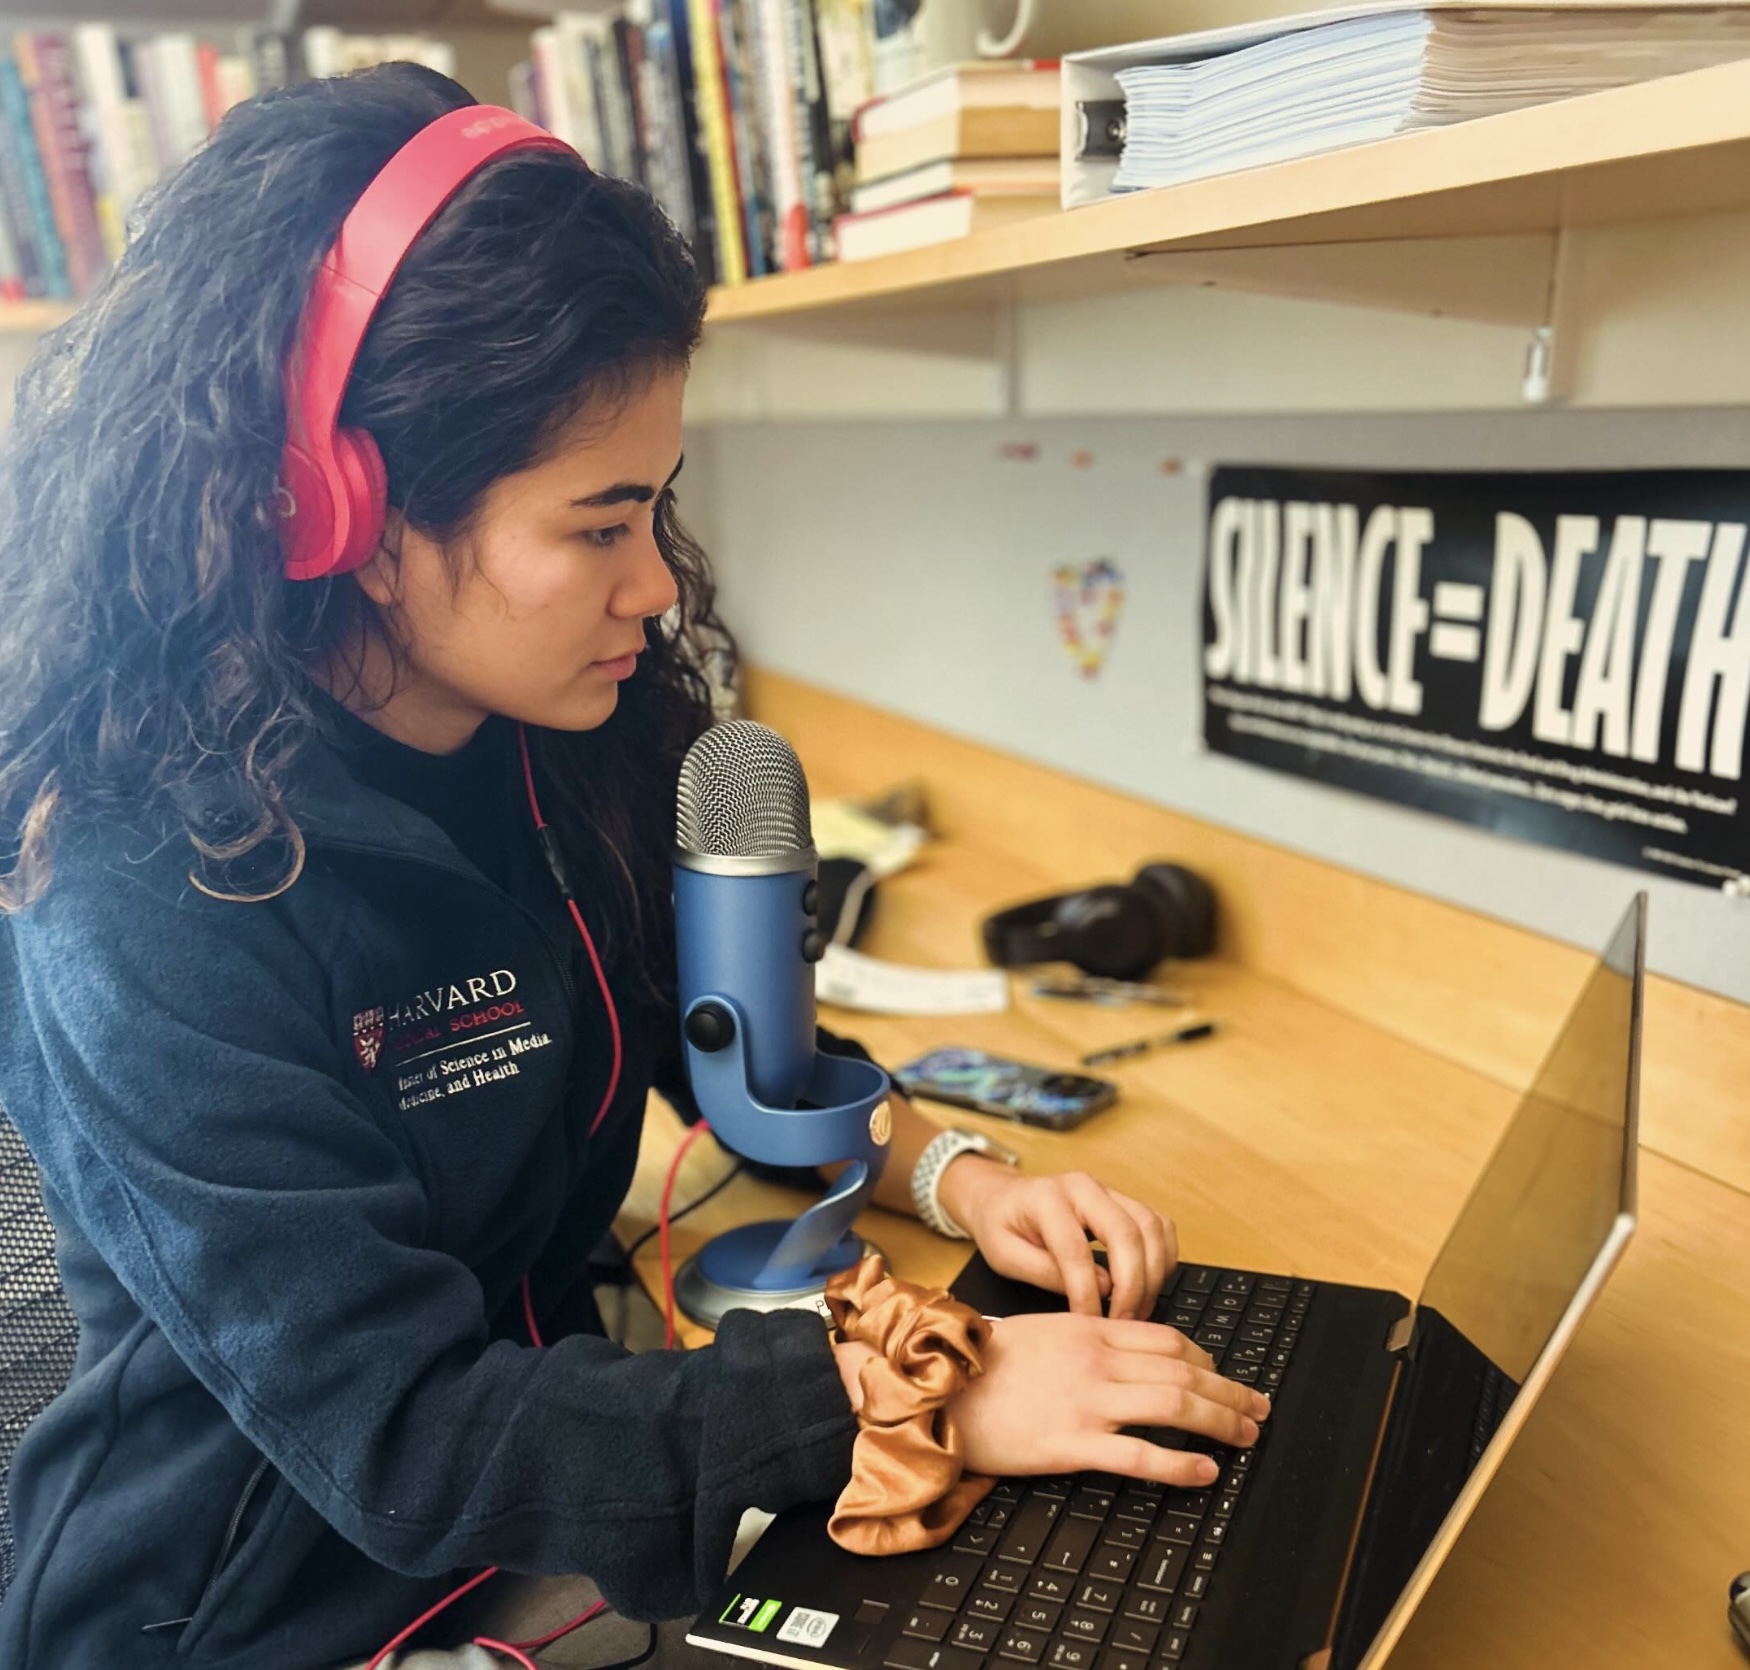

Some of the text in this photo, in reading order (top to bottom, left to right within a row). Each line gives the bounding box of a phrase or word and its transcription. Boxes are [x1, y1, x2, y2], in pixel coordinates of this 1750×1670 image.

[449, 1001, 524, 1032] SCHOOL
[440, 1050, 490, 1075] Science
[492, 1046, 508, 1061] in
[446, 1073, 471, 1095] and
[472, 1060, 520, 1087] Health
[1216, 1315, 1230, 1324] W
[945, 1576, 959, 1586] 0
[1046, 1582, 1058, 1592] 4
[1094, 1594, 1107, 1602] 7
[984, 1601, 998, 1610] 2
[1031, 1611, 1046, 1621] 5
[1080, 1621, 1094, 1630] 8
[969, 1630, 984, 1640] 3
[1017, 1641, 1031, 1650] 6
[1065, 1650, 1082, 1662] 9
